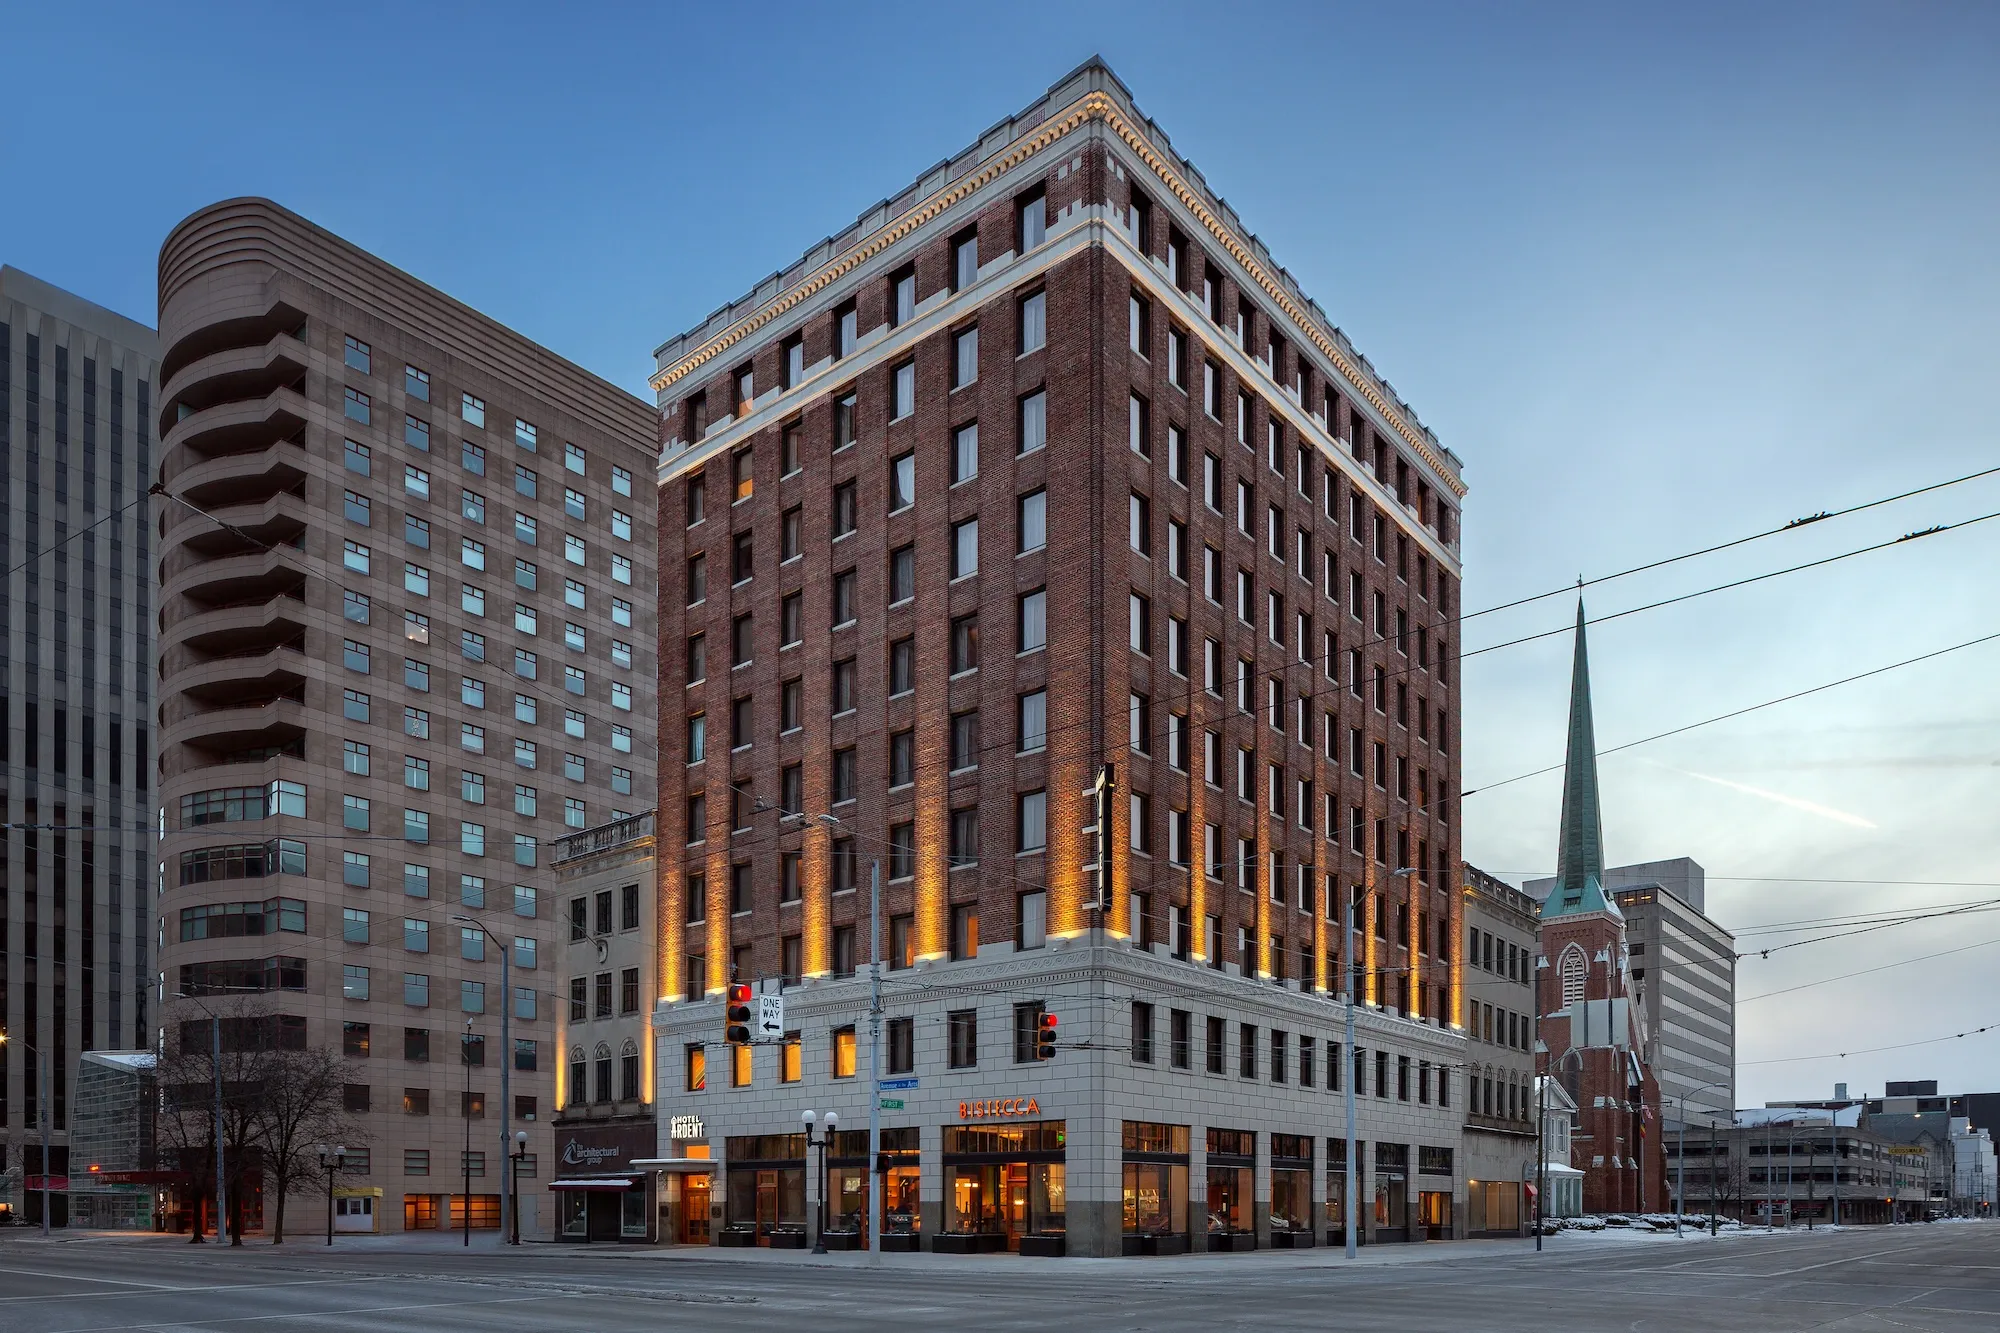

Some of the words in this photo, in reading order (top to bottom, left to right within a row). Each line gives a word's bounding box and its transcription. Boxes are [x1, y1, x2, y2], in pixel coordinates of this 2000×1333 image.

[763, 998, 780, 1009] ONE
[762, 1009, 780, 1019] WAY
[959, 1097, 1040, 1119] BISTECCA
[677, 1115, 700, 1124] HOTEL
[671, 1120, 703, 1139] ARDENT
[577, 1146, 619, 1158] architectural
[587, 1157, 603, 1165] group
